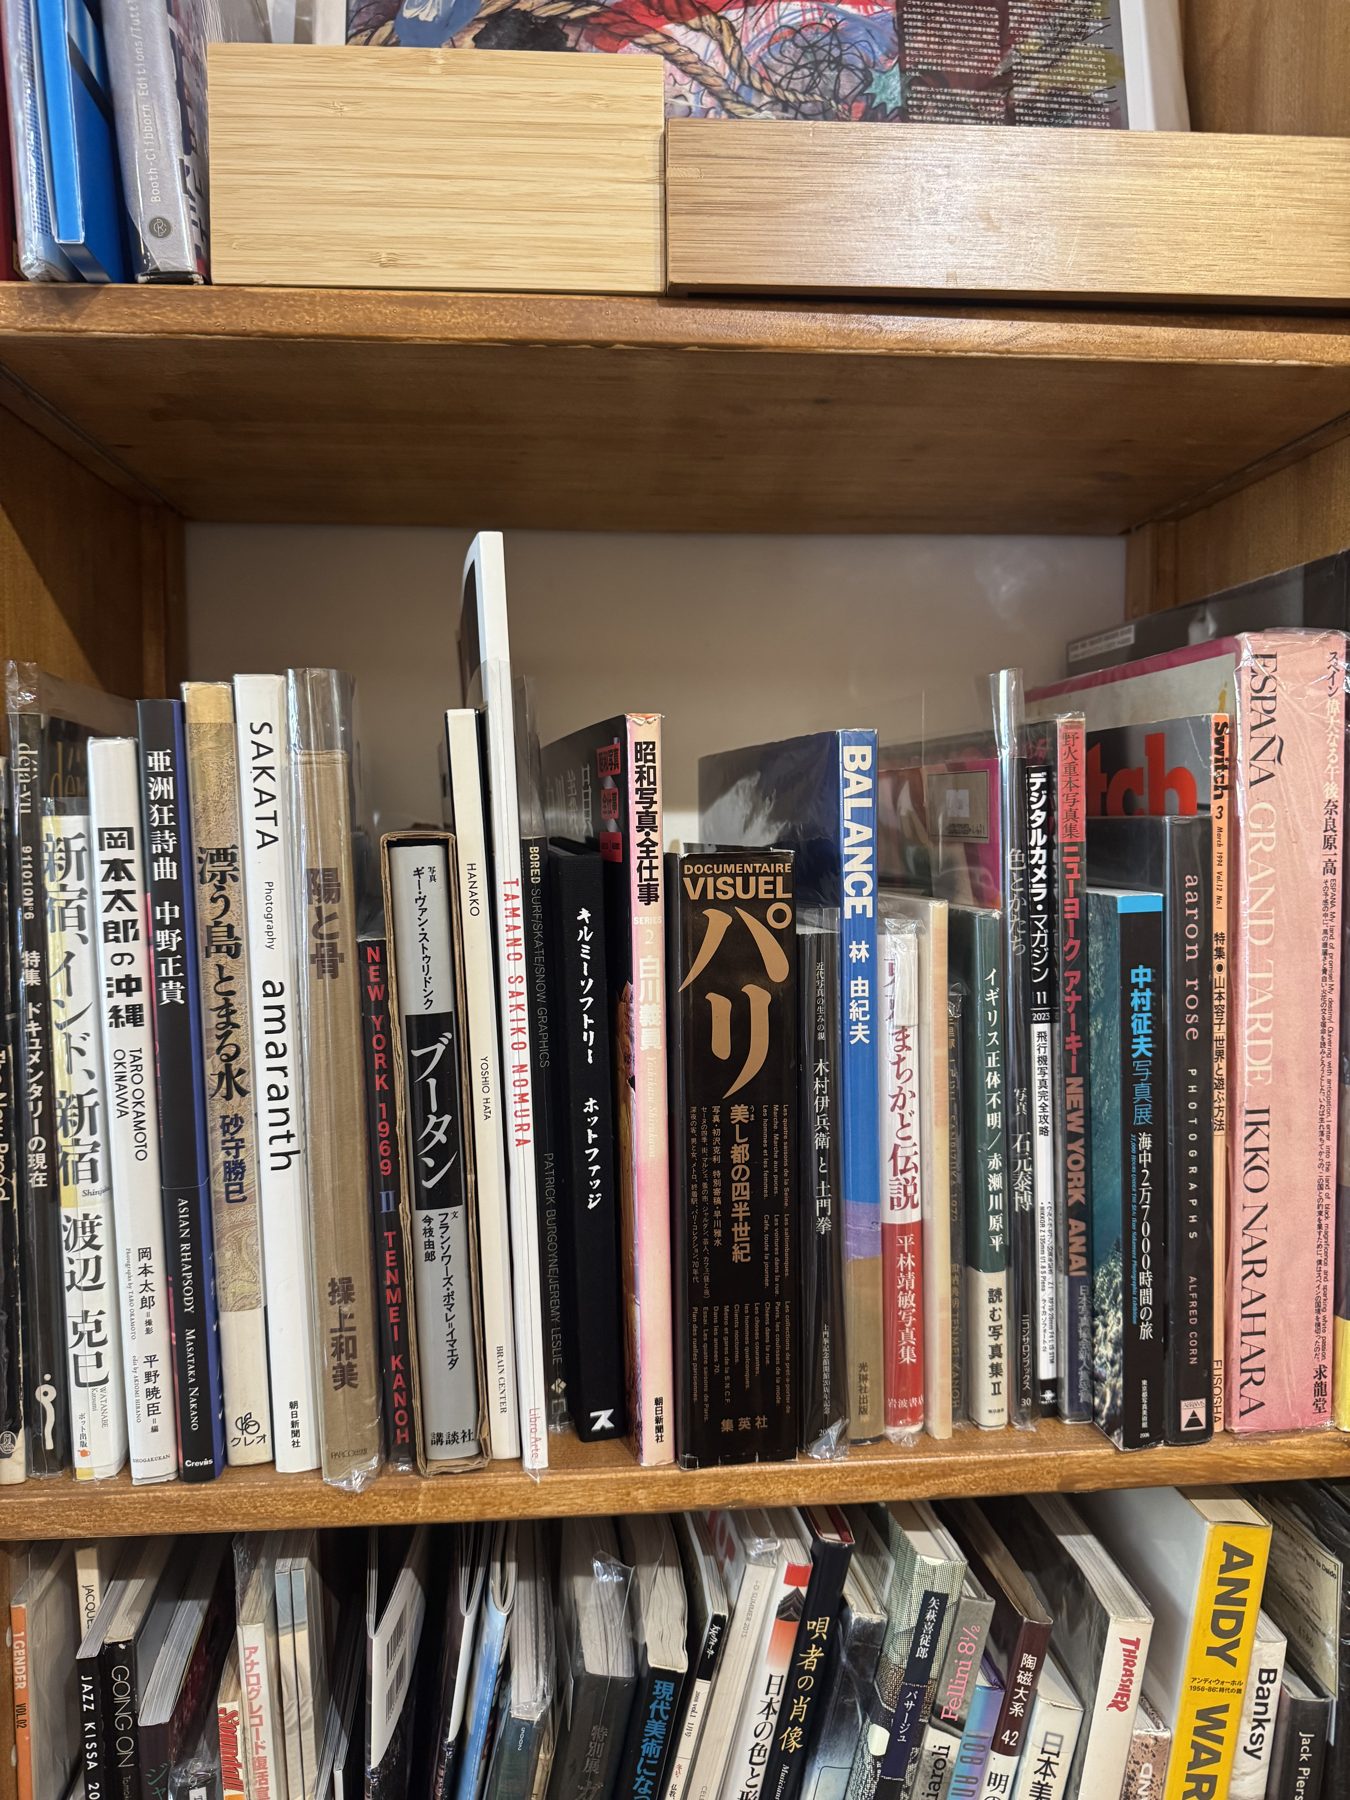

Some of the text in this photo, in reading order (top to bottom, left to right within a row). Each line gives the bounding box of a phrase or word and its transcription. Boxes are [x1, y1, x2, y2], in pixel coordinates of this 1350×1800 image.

[249, 722, 280, 851] SAKATA
[1212, 721, 1230, 801] Switch
[634, 740, 661, 907] 昭和写真・全仕事
[842, 745, 874, 920] BALANCE
[1214, 805, 1224, 820] 3
[1216, 826, 1224, 848] March
[1216, 851, 1224, 867] 1994
[146, 749, 187, 1006] 亜洲狂詩曲 中野正貴
[466, 862, 481, 917] HANAKO
[683, 863, 792, 875] DOCUMENTAIRE
[683, 875, 793, 901] VISUEL
[1245, 652, 1285, 1088] ESPAÑA GRAND TARDE
[98, 827, 145, 1030] 岡本太郎の沖縄
[263, 881, 278, 952] Photography
[528, 846, 551, 1068] BORED SURF/SKATE/SNOW GRAPHICS
[644, 929, 655, 945] 2
[1062, 845, 1084, 1075] ニューヨーク アナーキー
[1184, 874, 1199, 1041] aaron rose
[197, 844, 250, 1101] 漂う島とまる水
[503, 878, 532, 1148] TAMANO SAKIKO NOMURA
[678, 901, 793, 1100] パリ
[848, 940, 870, 1045] 林 由紀夫
[1031, 1012, 1051, 1021] 2023
[1036, 991, 1046, 1005] 11
[23, 951, 49, 1188] 特集 ドキュメンタリーの現在
[113, 1049, 130, 1120] OKINAWA
[261, 979, 302, 1172] amaranth
[480, 1056, 492, 1121] YOSHIO HATA
[576, 907, 603, 1210] キルミーソフトリー ホットファッジ
[885, 958, 920, 1212] まちかど伝説
[1035, 1030, 1050, 1137] 飛行機写真完全攻略
[1130, 964, 1154, 1126] 中村征夫写真展
[129, 1047, 148, 1162] TARO OKAMOTO
[410, 1031, 460, 1190] ブータン
[813, 1058, 832, 1236] 木村伊兵衛と土門拳
[1065, 1076, 1085, 1133] NEW
[366, 945, 410, 1446] NEW YORK 1969 TENMEI KANOH
[730, 1103, 752, 1264] 美し都の四半世紀
[1011, 1131, 1034, 1212] 石元泰博
[1066, 1137, 1087, 1207] YORK
[63, 1212, 107, 1294] 渡辺
[177, 1198, 196, 1314] ASIAN RHAPSODY
[421, 1214, 437, 1263] 今枝由郎
[543, 1153, 556, 1206] PATRICK
[552, 1328, 563, 1366] LESLIE
[1238, 1104, 1271, 1420] IKKO NARAHARA
[1188, 1275, 1198, 1366] ALFRED CORN
[185, 1328, 201, 1432] MASATAKA NAKANO
[288, 1400, 302, 1449] 朝日新聞社
[495, 1344, 508, 1414] BRAIN CENTER
[654, 1396, 664, 1444] 朝日新聞社
[720, 1415, 768, 1433] 集英社
[1020, 1397, 1032, 1407] 30
[1312, 1364, 1328, 1414] 求龍堂
[230, 1433, 268, 1448] クレオ
[430, 1428, 476, 1447] 講談社
[1204, 1540, 1255, 1669] ANDY
[111, 1665, 134, 1777] GOING ON
[778, 1616, 830, 1754] 唄者の肖像
[896, 1690, 918, 1744] パサージュ
[939, 1658, 973, 1722] Fellini
[1008, 1652, 1037, 1718] 陶磁大系
[1105, 1636, 1142, 1713] THRASHER
[1243, 1667, 1279, 1762] Banksy
[80, 1675, 98, 1771] JAZZ KISSA
[1000, 1729, 1019, 1747] 42
[1299, 1731, 1316, 1762] Jack
